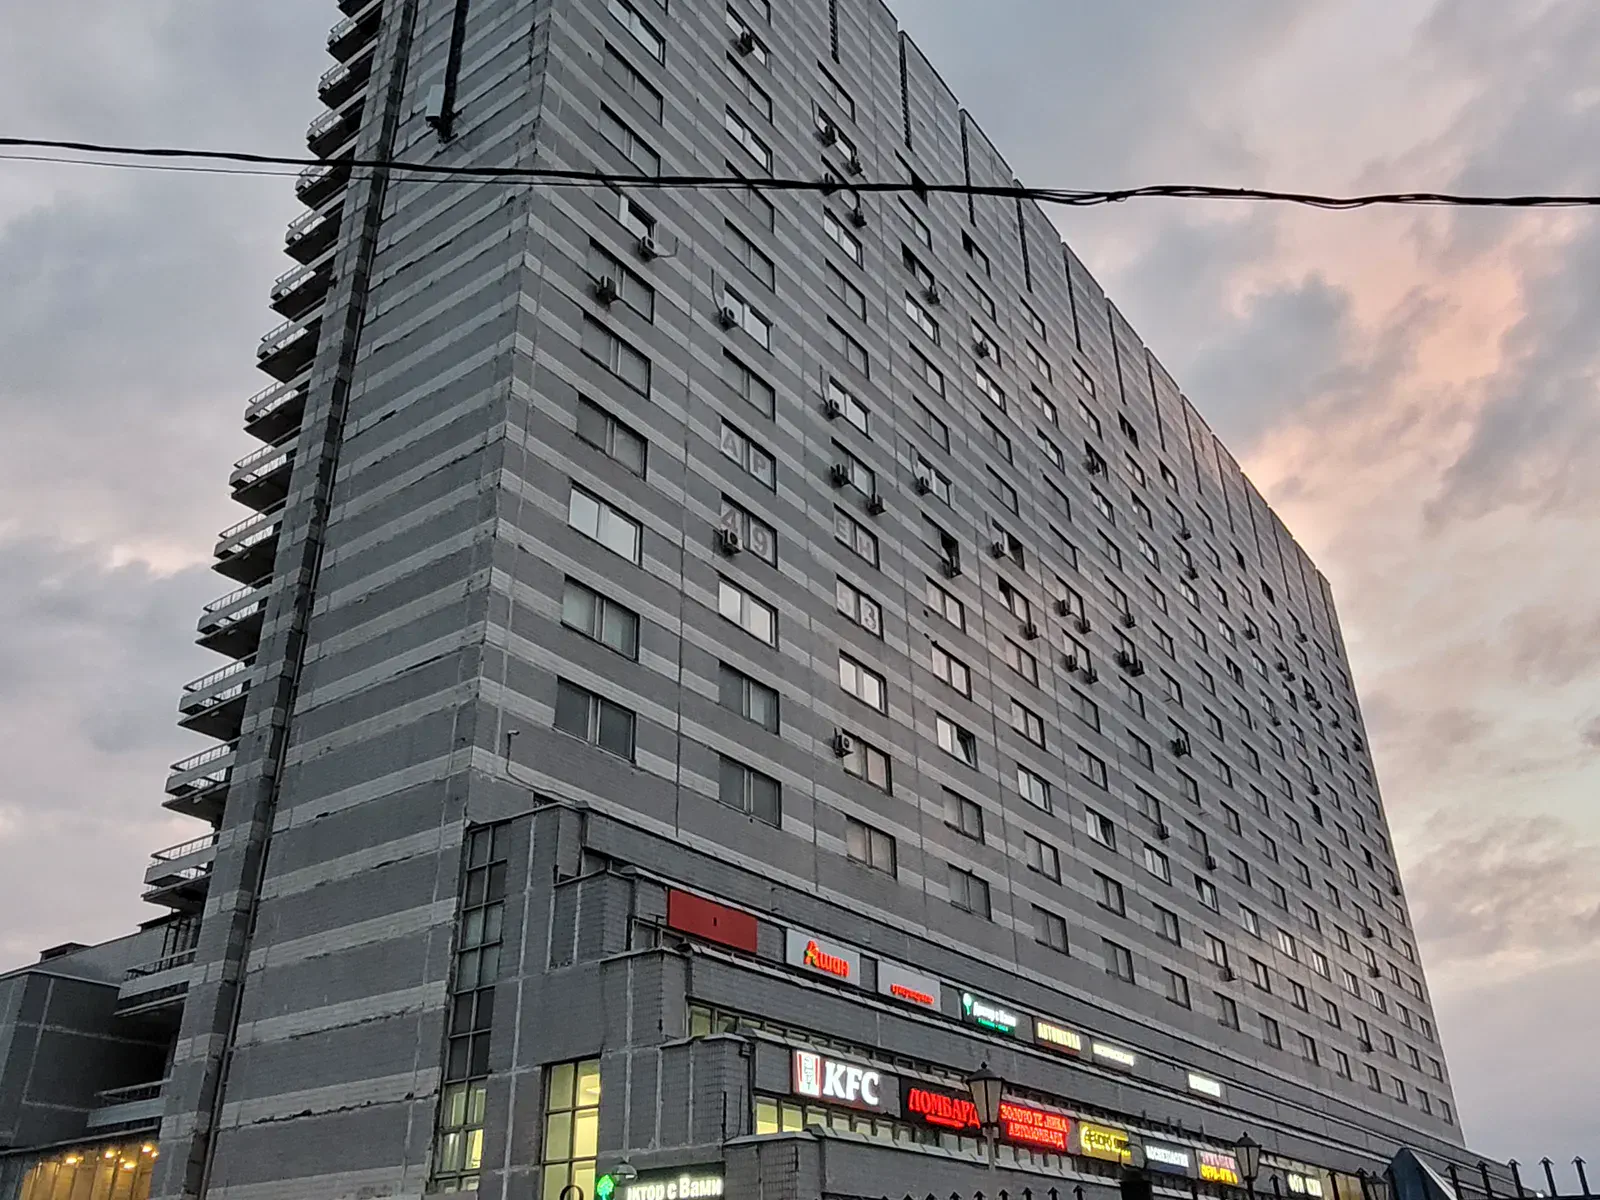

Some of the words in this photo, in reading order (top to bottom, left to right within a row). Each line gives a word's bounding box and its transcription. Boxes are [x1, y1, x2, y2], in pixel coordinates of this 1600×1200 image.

[803, 940, 850, 978] Ашан
[822, 1060, 880, 1105] KFC
[908, 1088, 981, 1129] ЛОМБАРД
[679, 1177, 722, 1198] Вами
